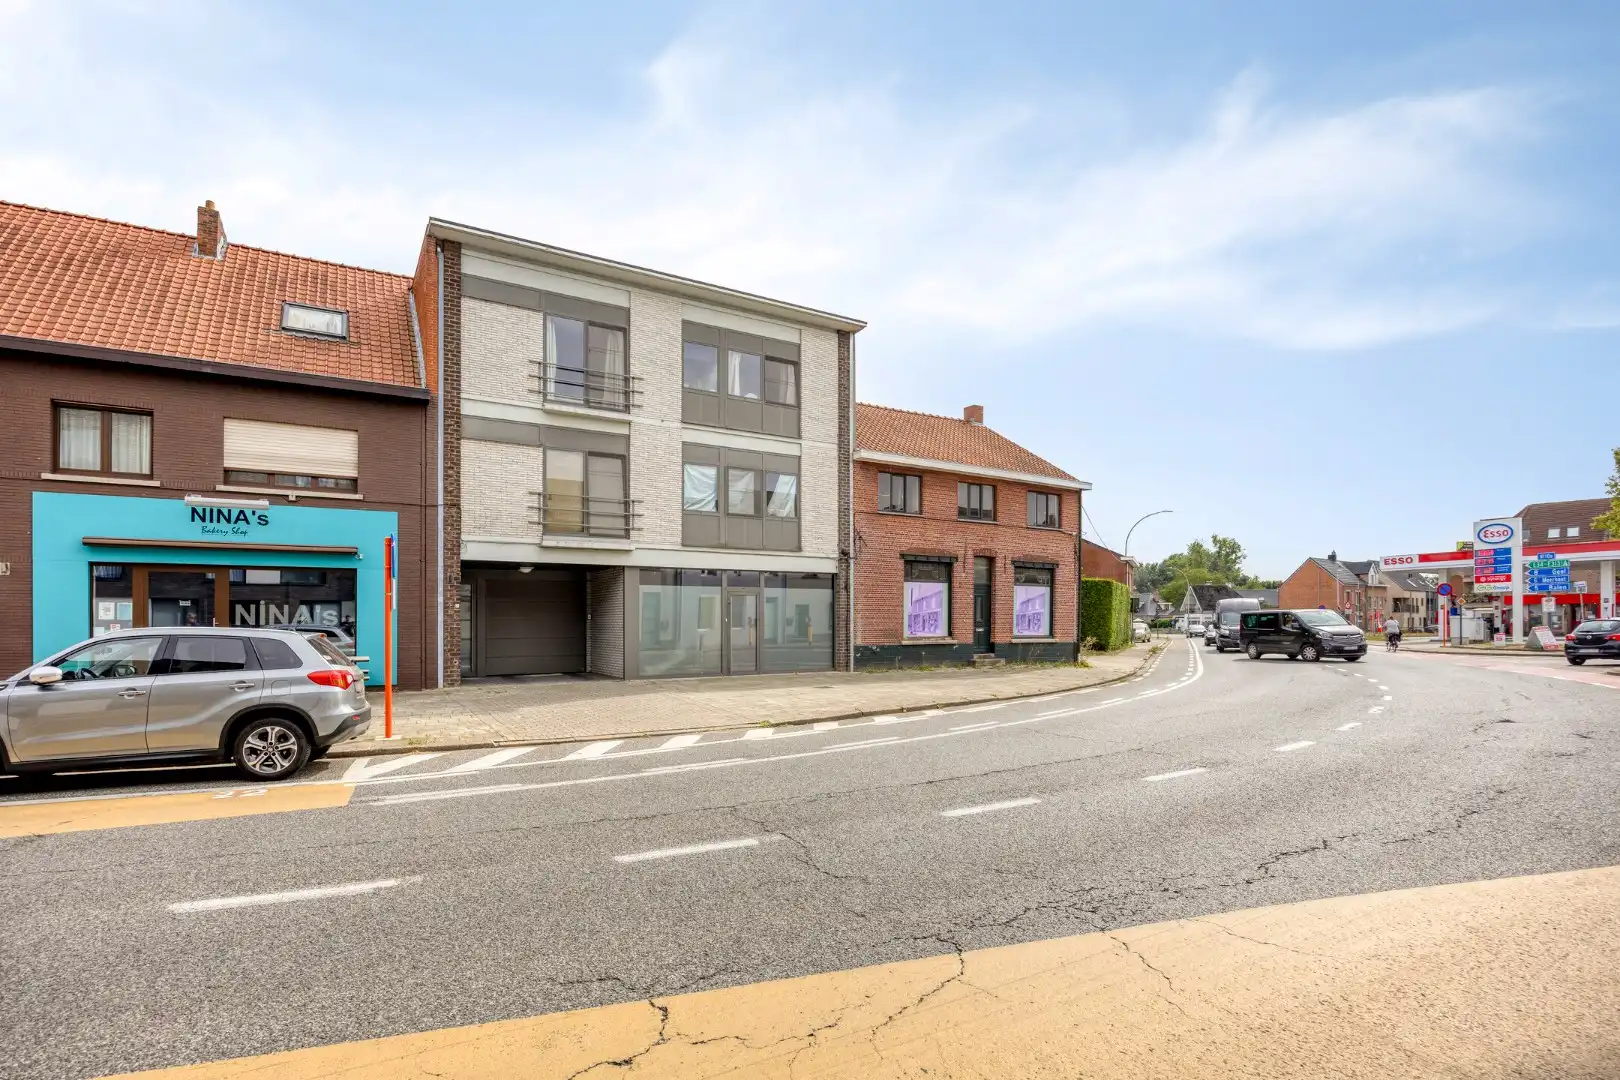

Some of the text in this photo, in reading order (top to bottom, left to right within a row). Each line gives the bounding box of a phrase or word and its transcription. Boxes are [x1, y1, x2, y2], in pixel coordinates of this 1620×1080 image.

[191, 506, 269, 526] NINA's
[201, 526, 248, 537] Bakery Shop
[1383, 556, 1413, 565] ESSO
